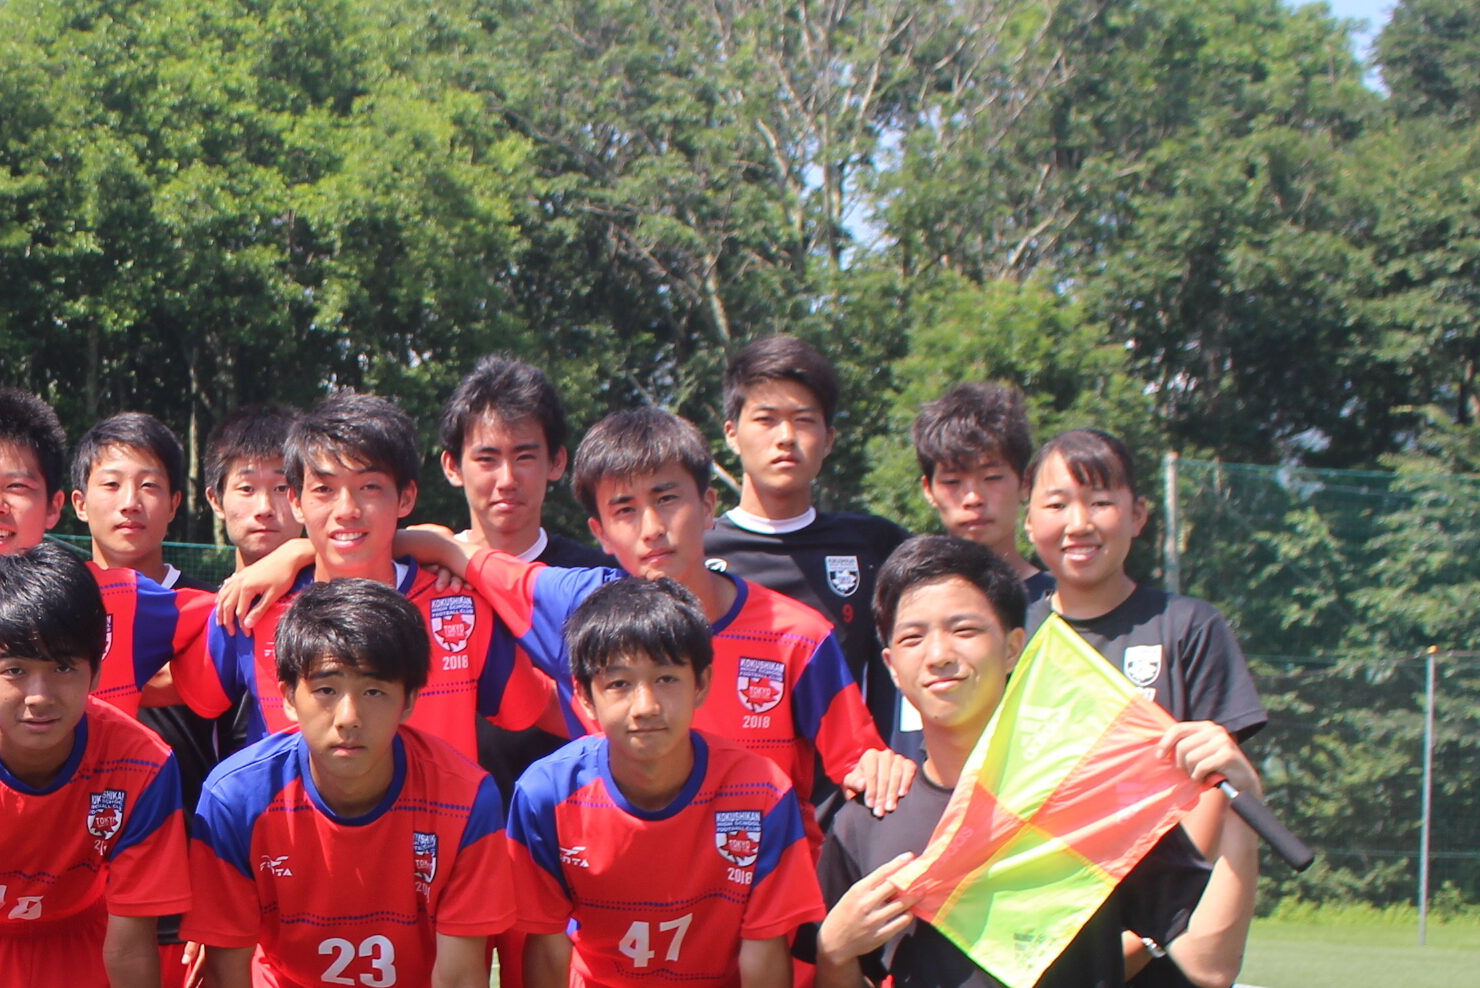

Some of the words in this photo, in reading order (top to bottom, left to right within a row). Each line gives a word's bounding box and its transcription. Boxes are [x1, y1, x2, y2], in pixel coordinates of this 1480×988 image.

[842, 603, 855, 623] 9
[442, 654, 469, 671] 2018
[742, 715, 771, 729] 2018
[560, 856, 590, 868] NTA
[727, 867, 753, 885] 2018
[619, 913, 693, 968] 47
[318, 934, 397, 988] 23
